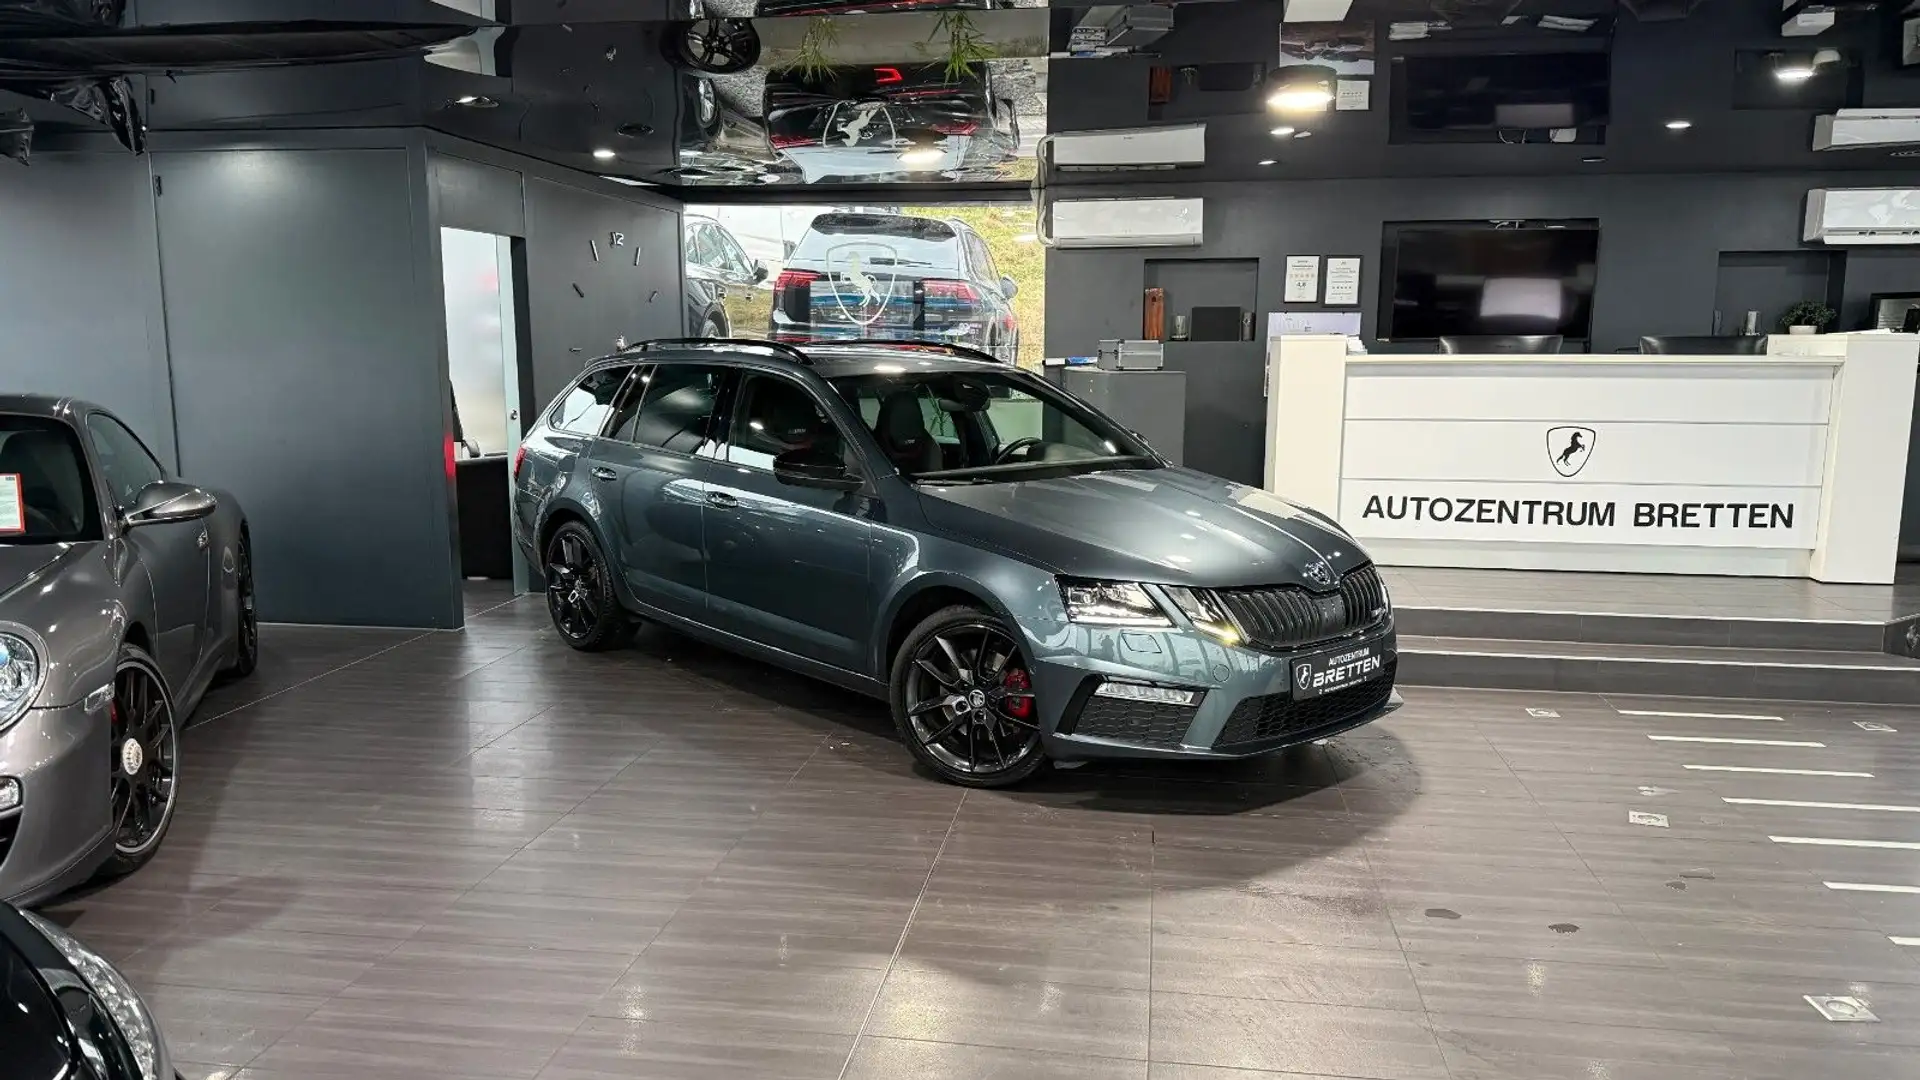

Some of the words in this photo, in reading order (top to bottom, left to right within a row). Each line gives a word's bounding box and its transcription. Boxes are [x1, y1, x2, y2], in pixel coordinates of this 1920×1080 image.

[1362, 495, 1616, 526] AUTOZENTRUM
[1633, 502, 1794, 528] BRETTEN
[1312, 654, 1380, 687] BRETTEN
